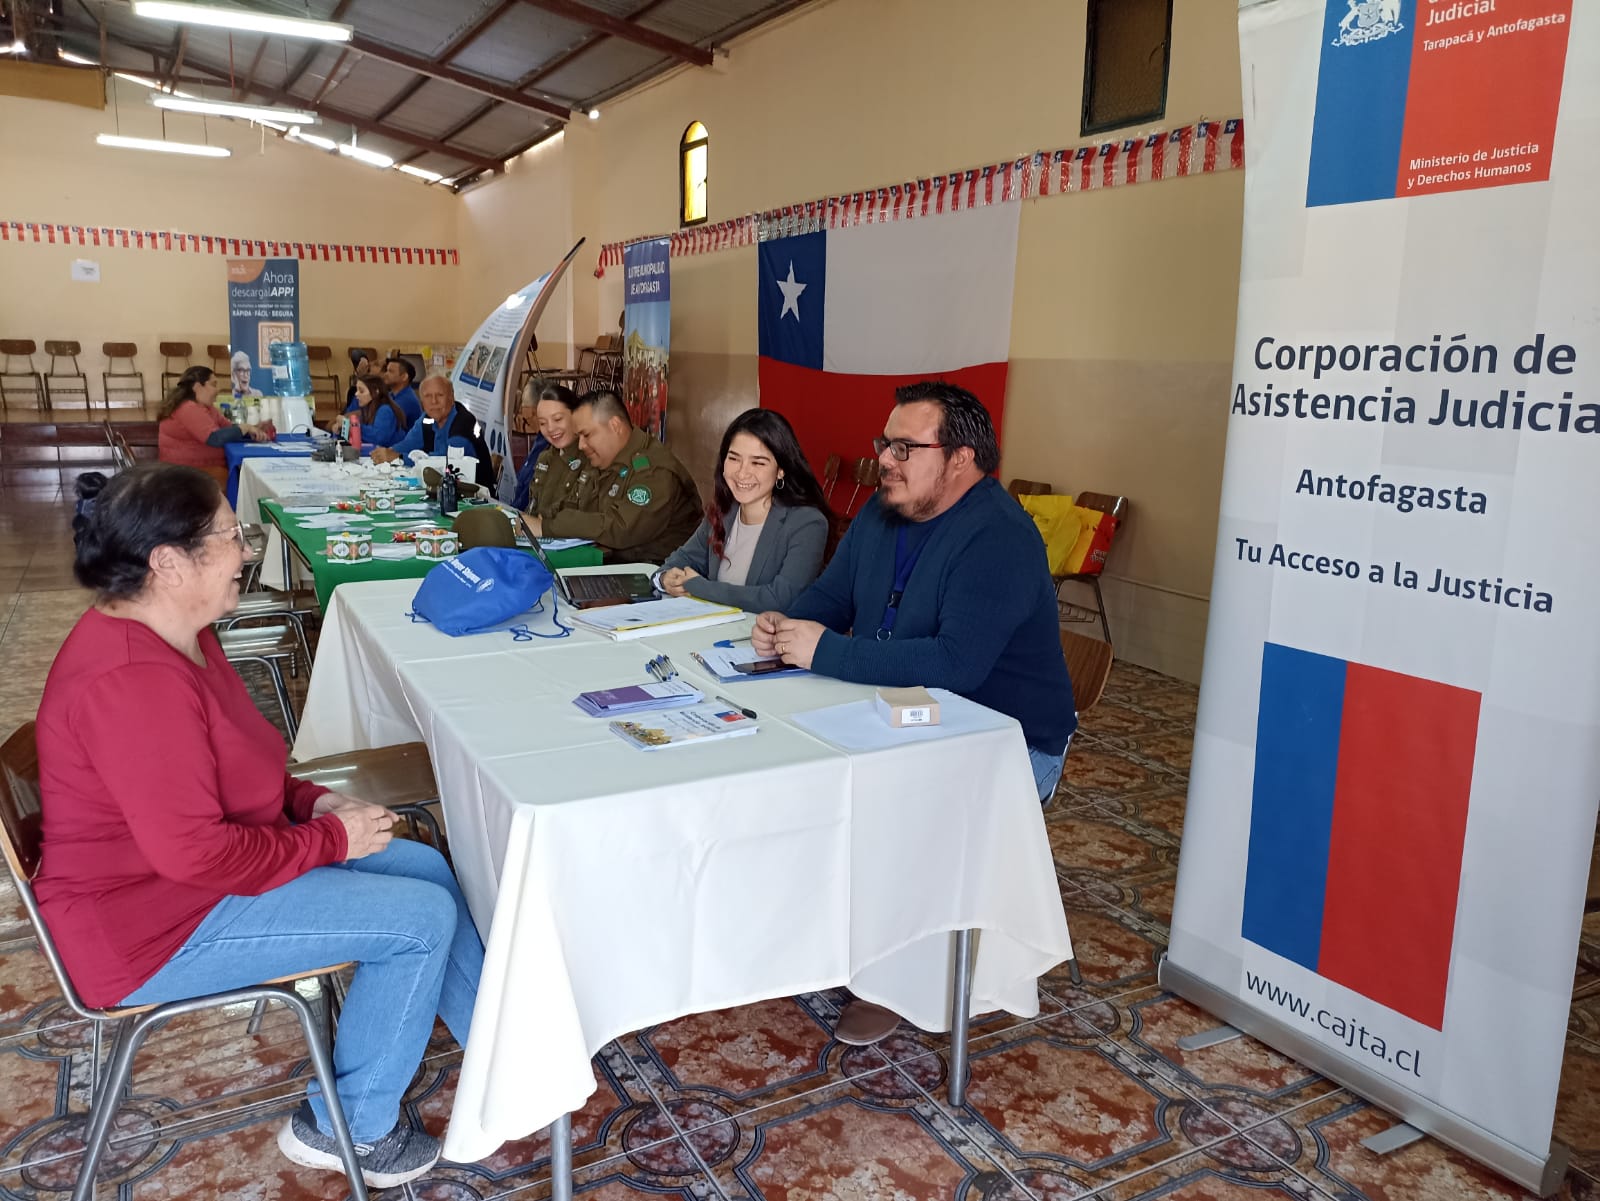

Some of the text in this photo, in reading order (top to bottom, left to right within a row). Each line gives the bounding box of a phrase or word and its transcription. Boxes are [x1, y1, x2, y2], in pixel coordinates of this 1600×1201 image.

[1423, 13, 1566, 51] Tarapacá y Antofagasta
[1425, 0, 1496, 26] Judicial
[1407, 161, 1532, 190] y Derechos Humanos
[1409, 142, 1539, 171] Ministerio de Justicia
[263, 270, 294, 284] Ahora
[1254, 333, 1577, 380] Corporación de
[1231, 383, 1600, 434] Asistencia Judicia
[1295, 469, 1488, 515] Antofagasta
[1235, 537, 1554, 614] Tu Acceso a la Justicia
[1246, 970, 1422, 1078] www.cajta.cl
